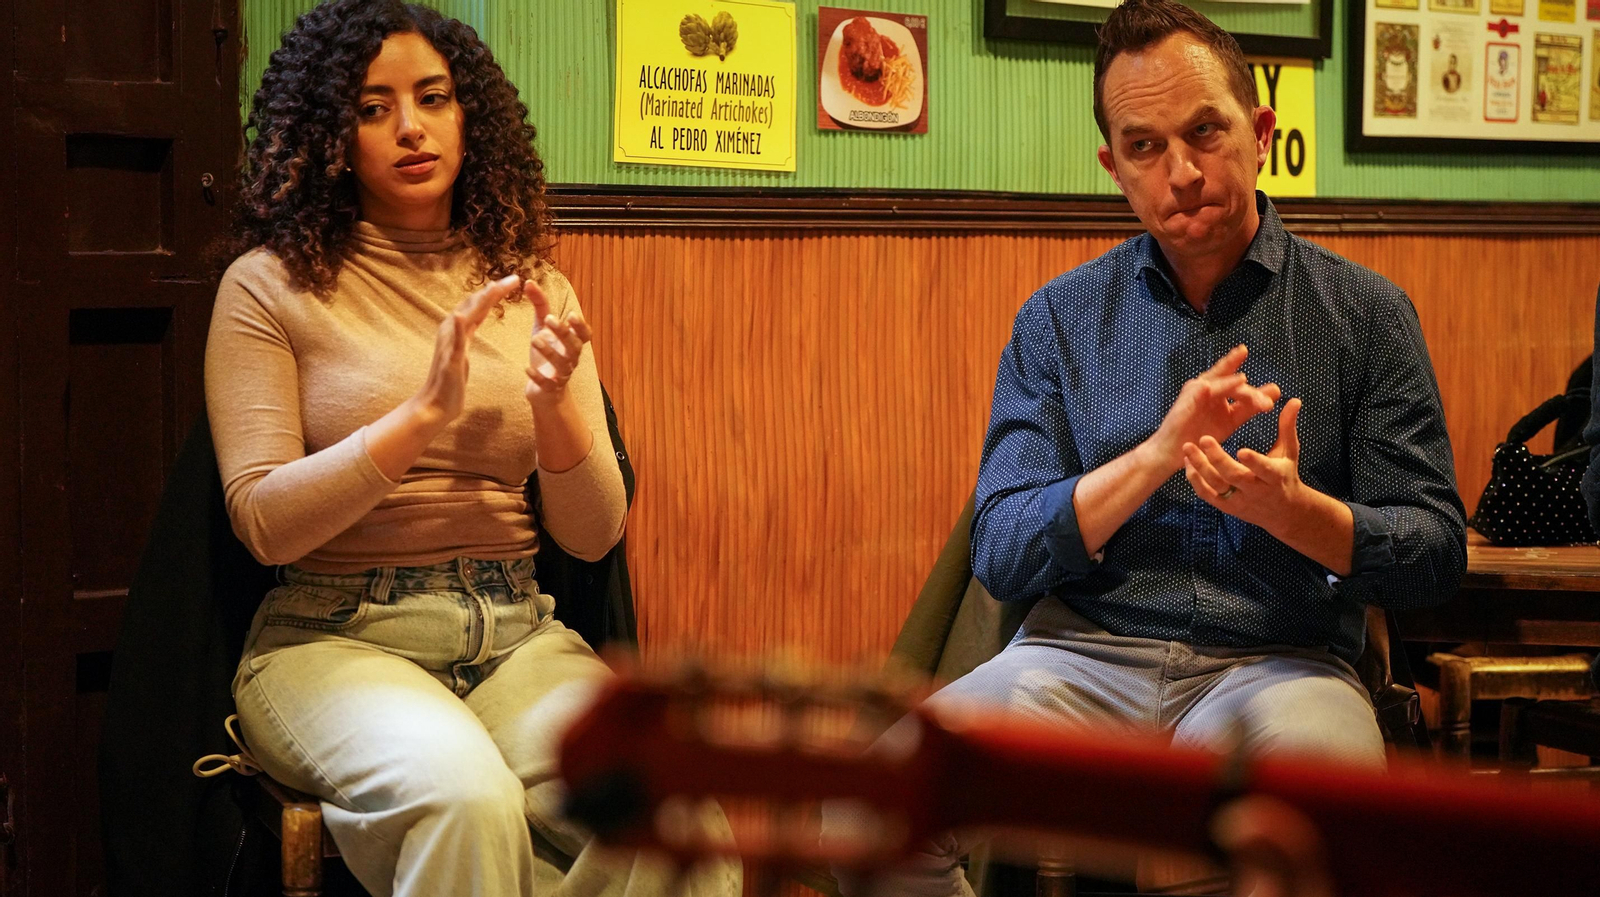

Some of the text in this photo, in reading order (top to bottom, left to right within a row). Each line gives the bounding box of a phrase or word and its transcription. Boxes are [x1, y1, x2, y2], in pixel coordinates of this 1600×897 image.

[639, 65, 776, 99] ALCACHOFAS MARINADAS
[640, 91, 774, 129] (Marinated Artichokes)
[650, 126, 762, 155] AL PEDRO XIMÉNEZ
[1258, 128, 1306, 177] TO
